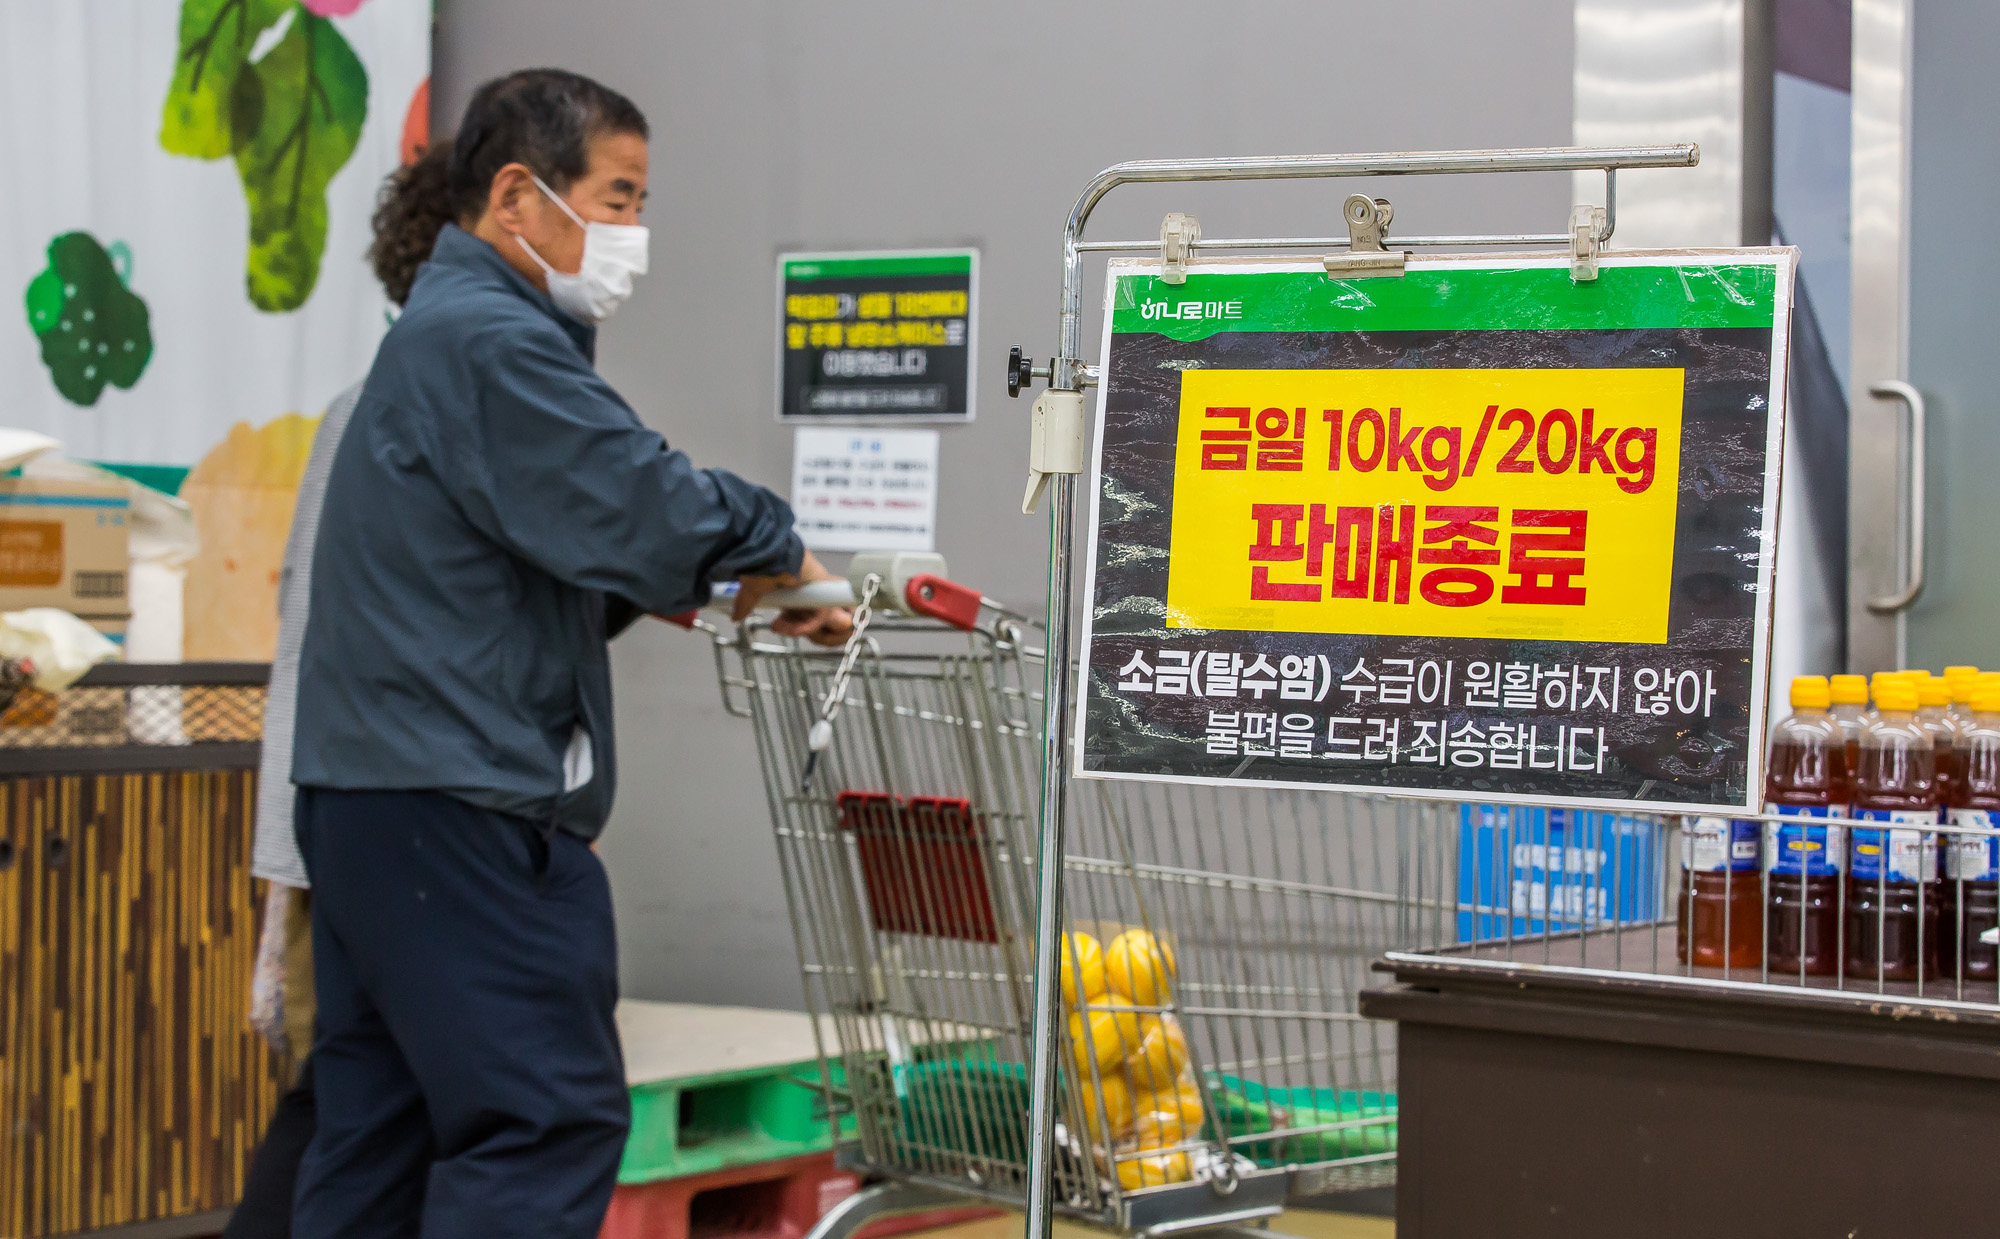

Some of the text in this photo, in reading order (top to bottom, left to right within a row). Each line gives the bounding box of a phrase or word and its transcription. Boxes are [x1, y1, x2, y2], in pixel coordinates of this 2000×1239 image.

[1140, 297, 1243, 321] 하나로마트
[1200, 405, 1658, 495] 금일 10kg/20kg
[1248, 503, 1588, 607] 판매종료
[1117, 649, 1717, 718] 소금(탈수염) 수급이 원활하지 않아
[1205, 710, 1609, 774] 불편을 드려 죄송합니다
